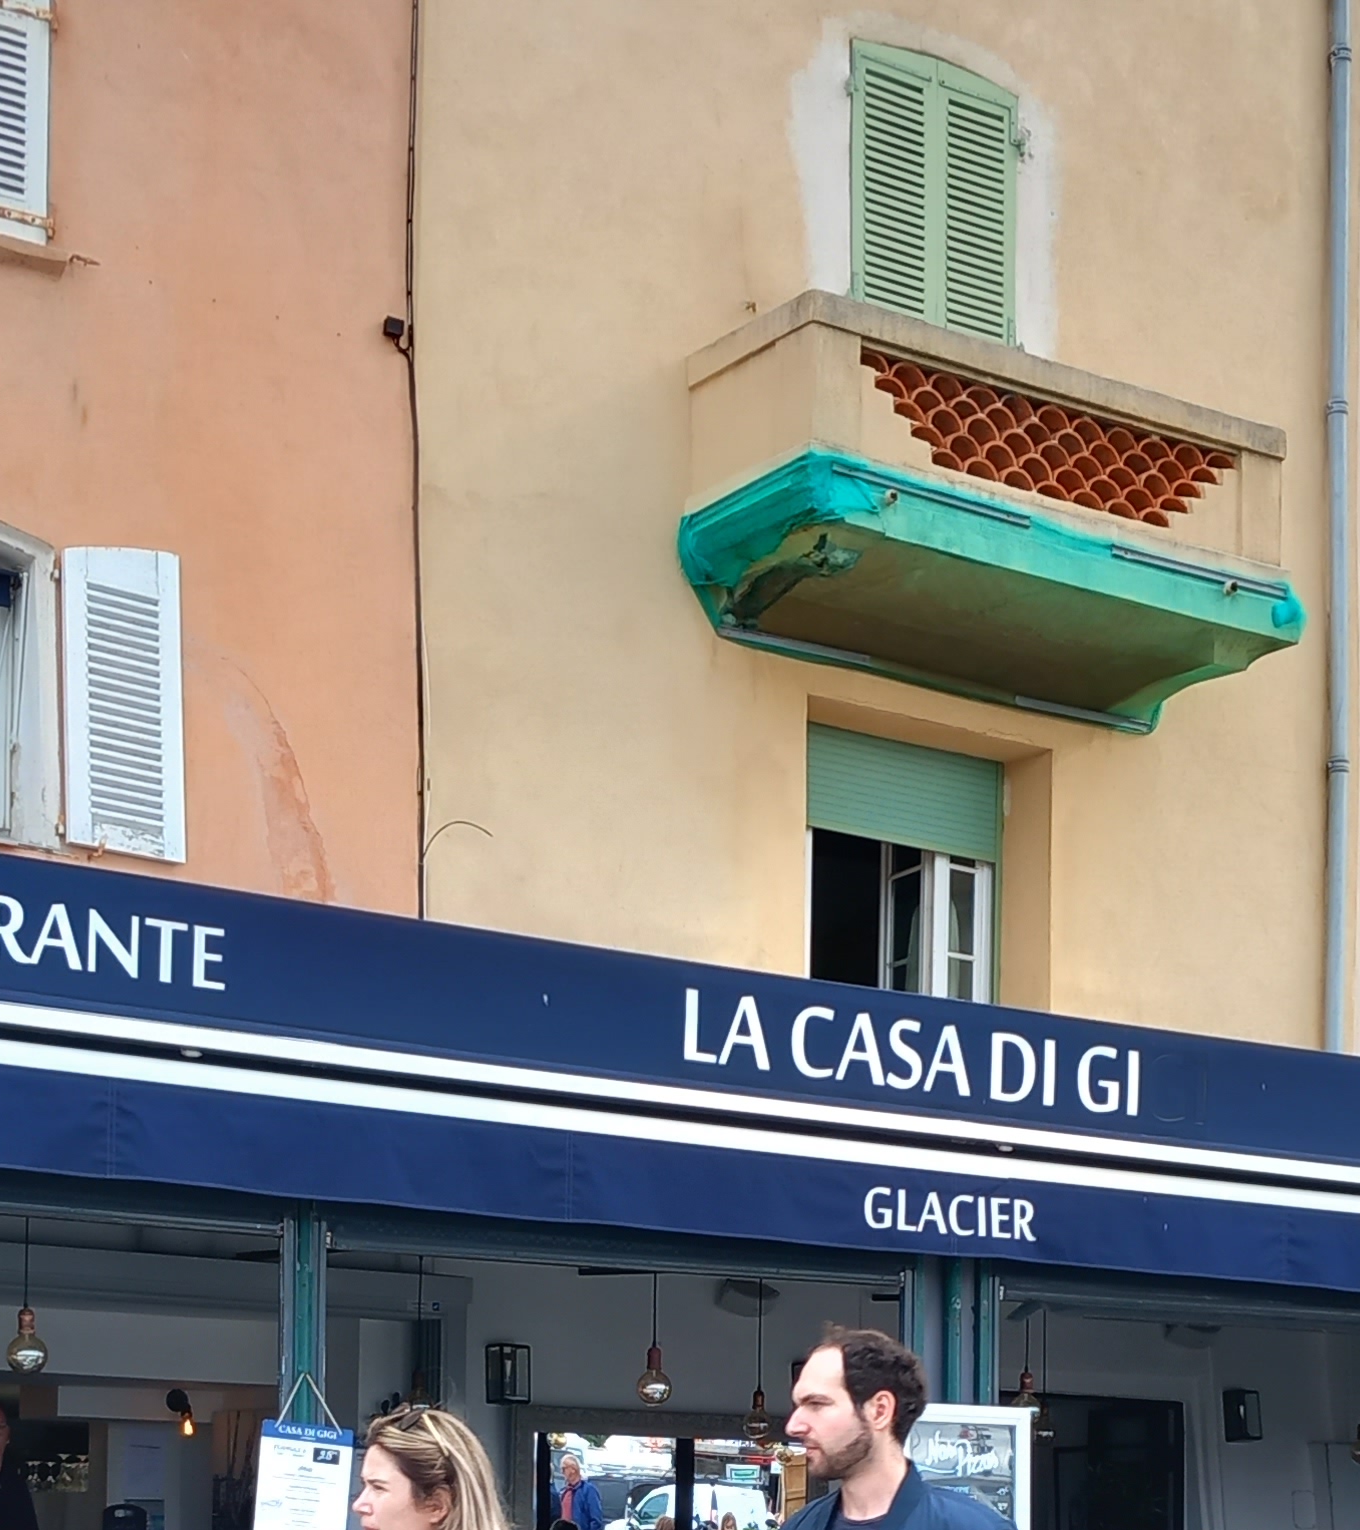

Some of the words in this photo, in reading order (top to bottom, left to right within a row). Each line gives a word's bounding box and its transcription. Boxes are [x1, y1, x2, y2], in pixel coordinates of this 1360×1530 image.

[684, 988, 771, 1071] LA
[792, 1006, 971, 1097] CASA
[990, 1032, 1056, 1107] DI
[1078, 1045, 1140, 1117] GI
[865, 1186, 1037, 1242] GLACIER
[278, 1424, 302, 1436] CASA
[304, 1428, 315, 1437] DI
[316, 1429, 337, 1440] GIGI
